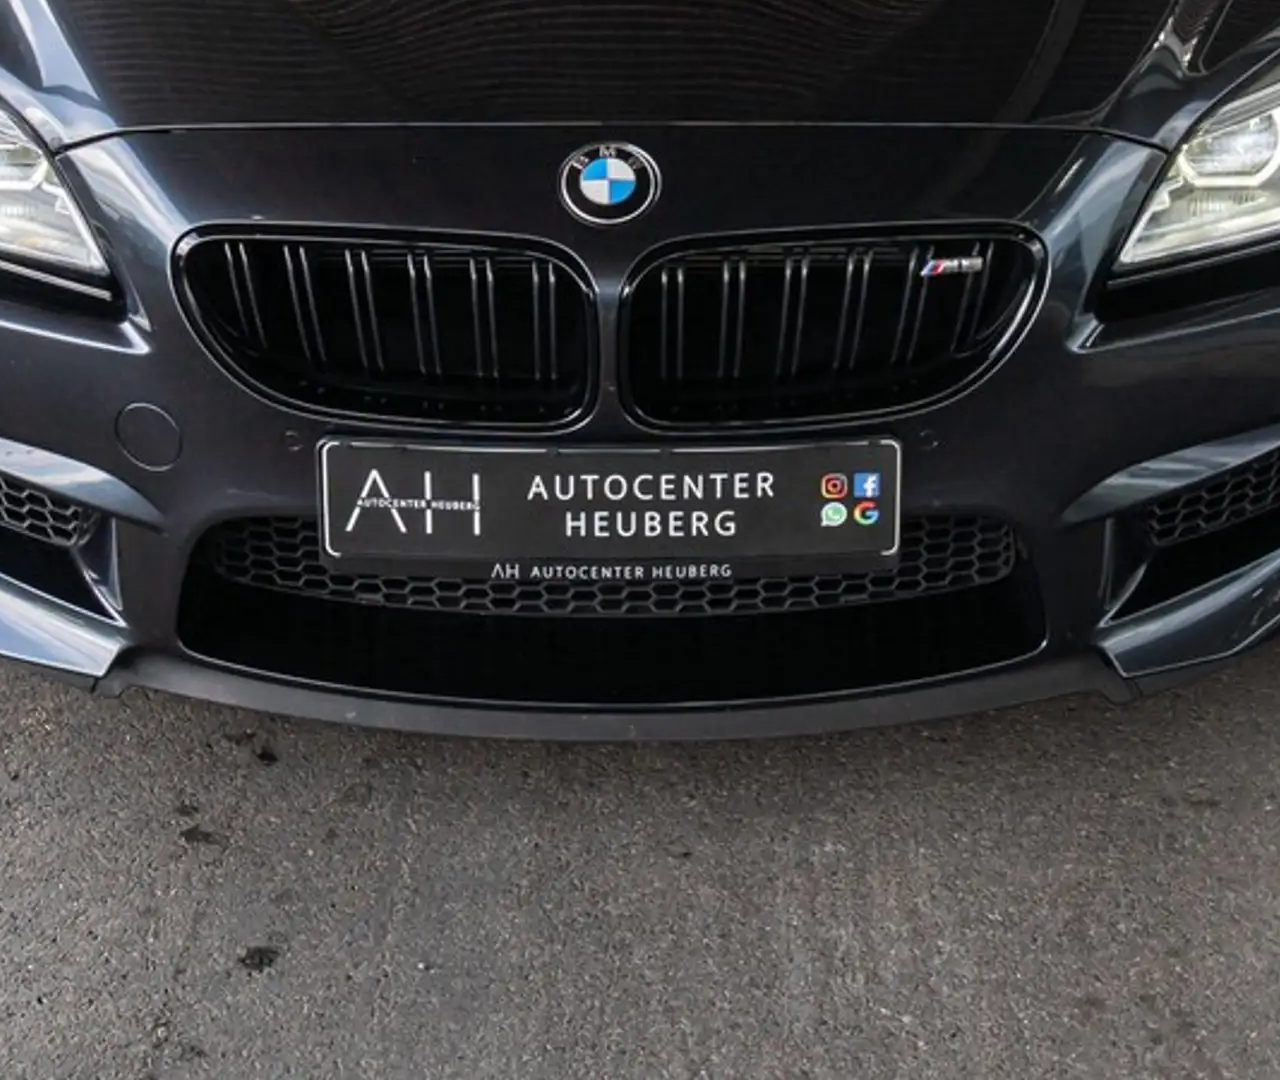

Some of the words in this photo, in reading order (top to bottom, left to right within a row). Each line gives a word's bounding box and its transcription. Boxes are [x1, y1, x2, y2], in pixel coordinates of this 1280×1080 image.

[526, 471, 776, 501] AUTOCENTER
[344, 469, 481, 536] AH
[356, 497, 427, 510] AUTOCENTER
[564, 510, 737, 538] HEUBERG
[491, 563, 520, 580] AH
[530, 565, 645, 580] AUTOCENTER
[651, 563, 733, 579] HEUBERG
